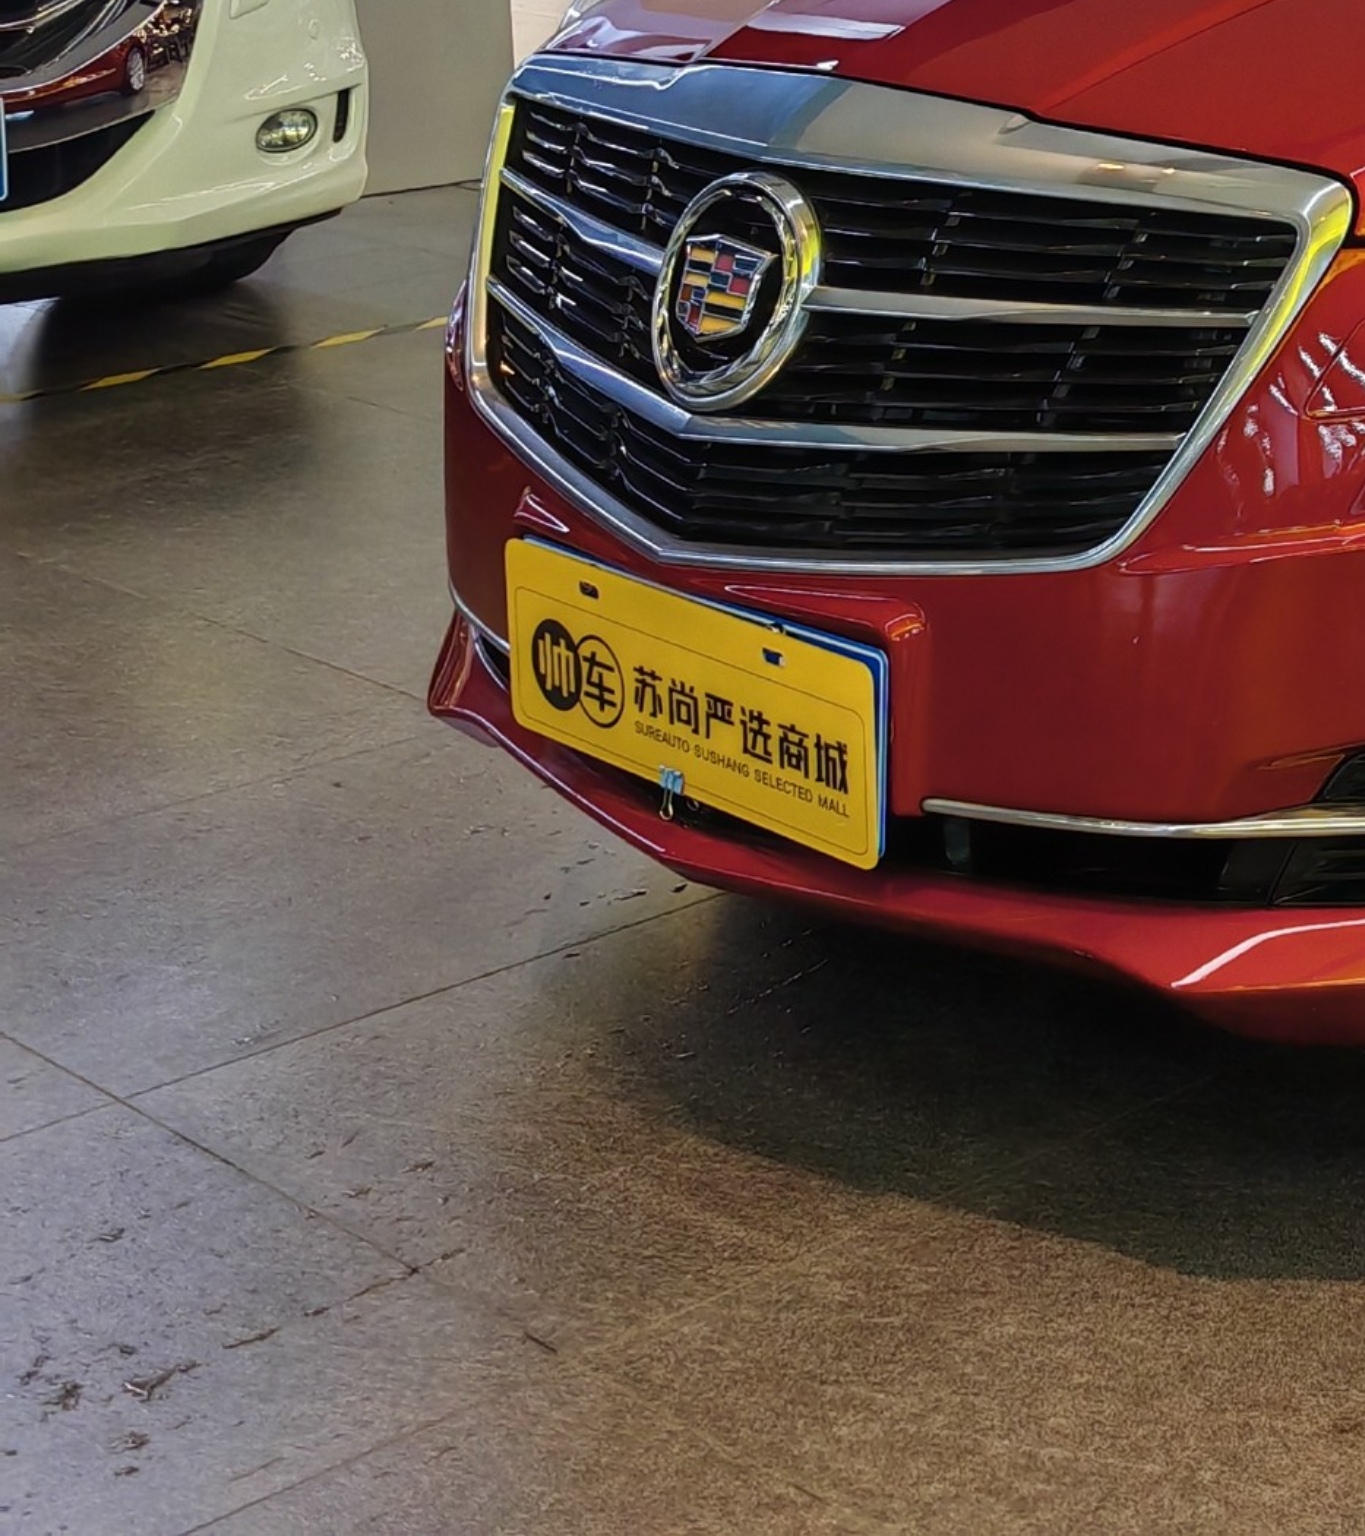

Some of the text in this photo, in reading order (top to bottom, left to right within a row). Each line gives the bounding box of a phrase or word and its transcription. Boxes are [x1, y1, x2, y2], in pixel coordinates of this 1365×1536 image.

[632, 665, 850, 796] 苏尚严选商城
[633, 719, 850, 818] SUREAUTO SUSHANG SELECTED MALL
